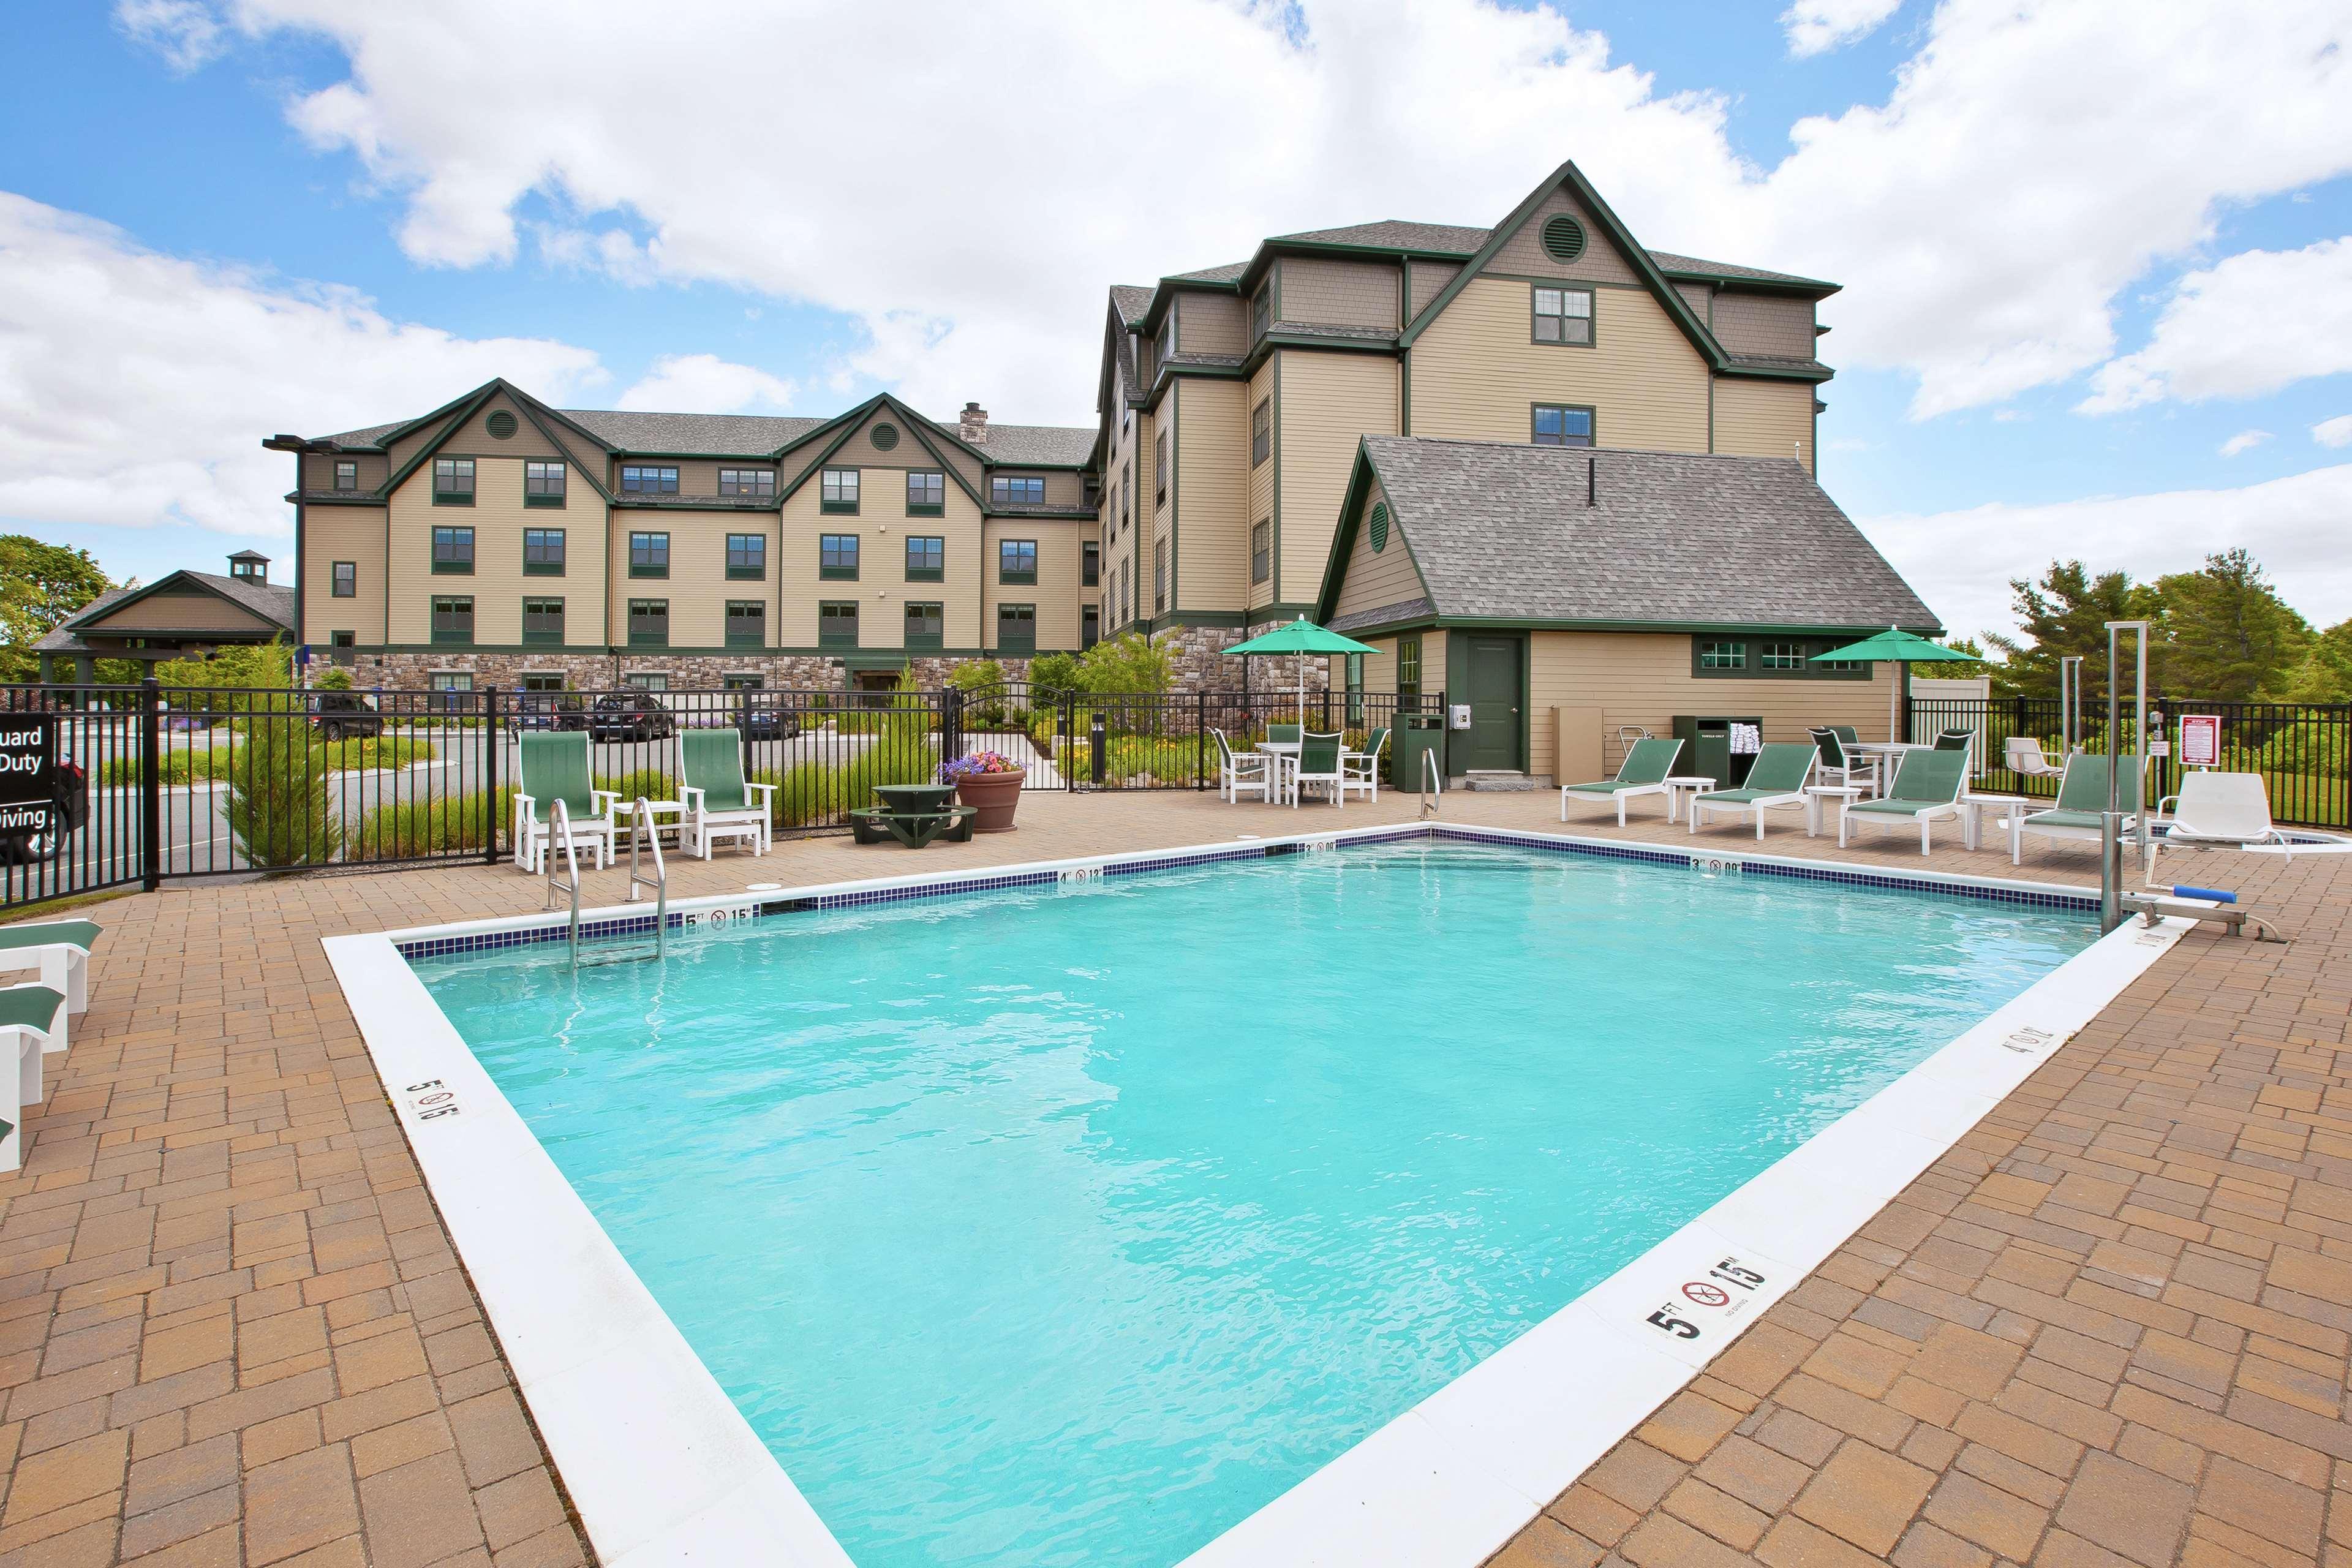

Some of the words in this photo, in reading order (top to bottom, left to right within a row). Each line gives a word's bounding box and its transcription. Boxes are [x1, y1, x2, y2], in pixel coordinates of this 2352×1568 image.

[0, 726, 42, 746] uard
[0, 753, 42, 775] Duty
[0, 807, 46, 829] iving
[686, 914, 696, 925] 5
[1661, 1302, 1683, 1316] FT
[1646, 1310, 1701, 1340] 5
